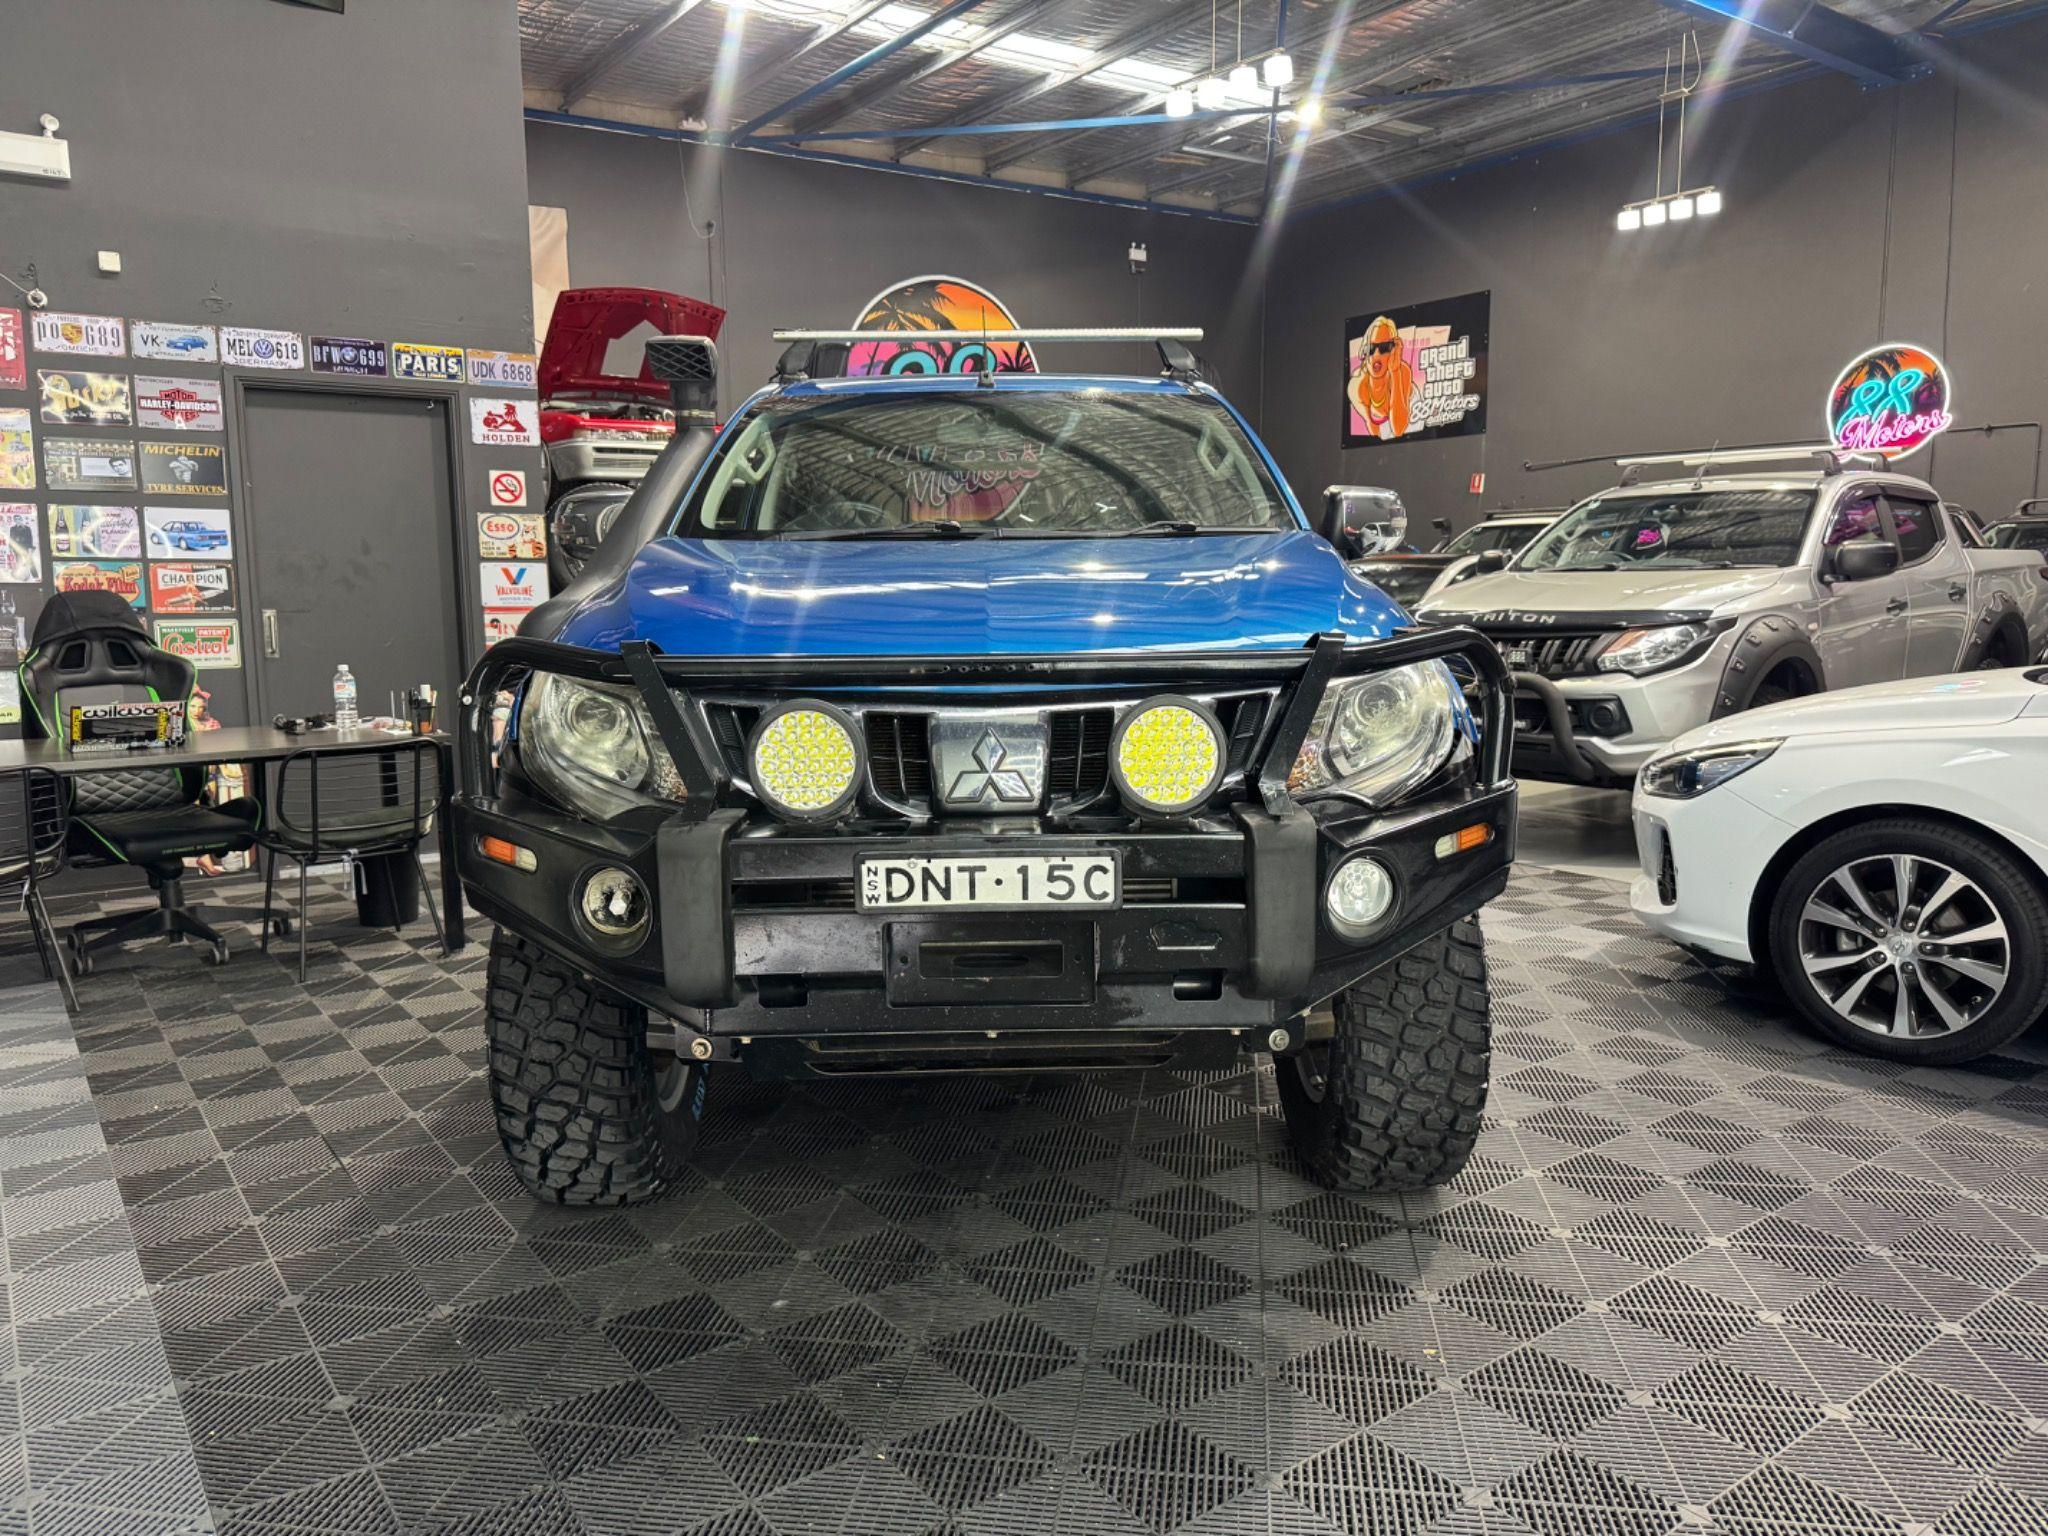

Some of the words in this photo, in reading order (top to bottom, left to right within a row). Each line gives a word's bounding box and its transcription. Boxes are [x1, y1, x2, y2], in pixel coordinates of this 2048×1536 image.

[226, 338, 254, 356] MEL
[275, 341, 299, 360] 618
[359, 348, 385, 367] 699
[400, 353, 459, 374] PARIS
[471, 361, 496, 379] UDK
[501, 363, 532, 382] 6868
[164, 390, 194, 400] MOTOR
[1424, 380, 1462, 399] auto
[140, 398, 217, 412] HARLEY-DAVIDSON
[1835, 368, 1924, 436] 88
[1840, 409, 1944, 449] Motors
[482, 433, 530, 443] HOLDEN
[144, 445, 220, 457] MICHELIN
[147, 483, 173, 491] TYRE
[175, 484, 224, 493] SERVICES
[161, 573, 223, 584] CHAMPION
[495, 585, 534, 597] VALVOLINE
[1472, 611, 1556, 624] TRITON
[198, 629, 226, 637] PATENT
[163, 627, 230, 655] Castrol
